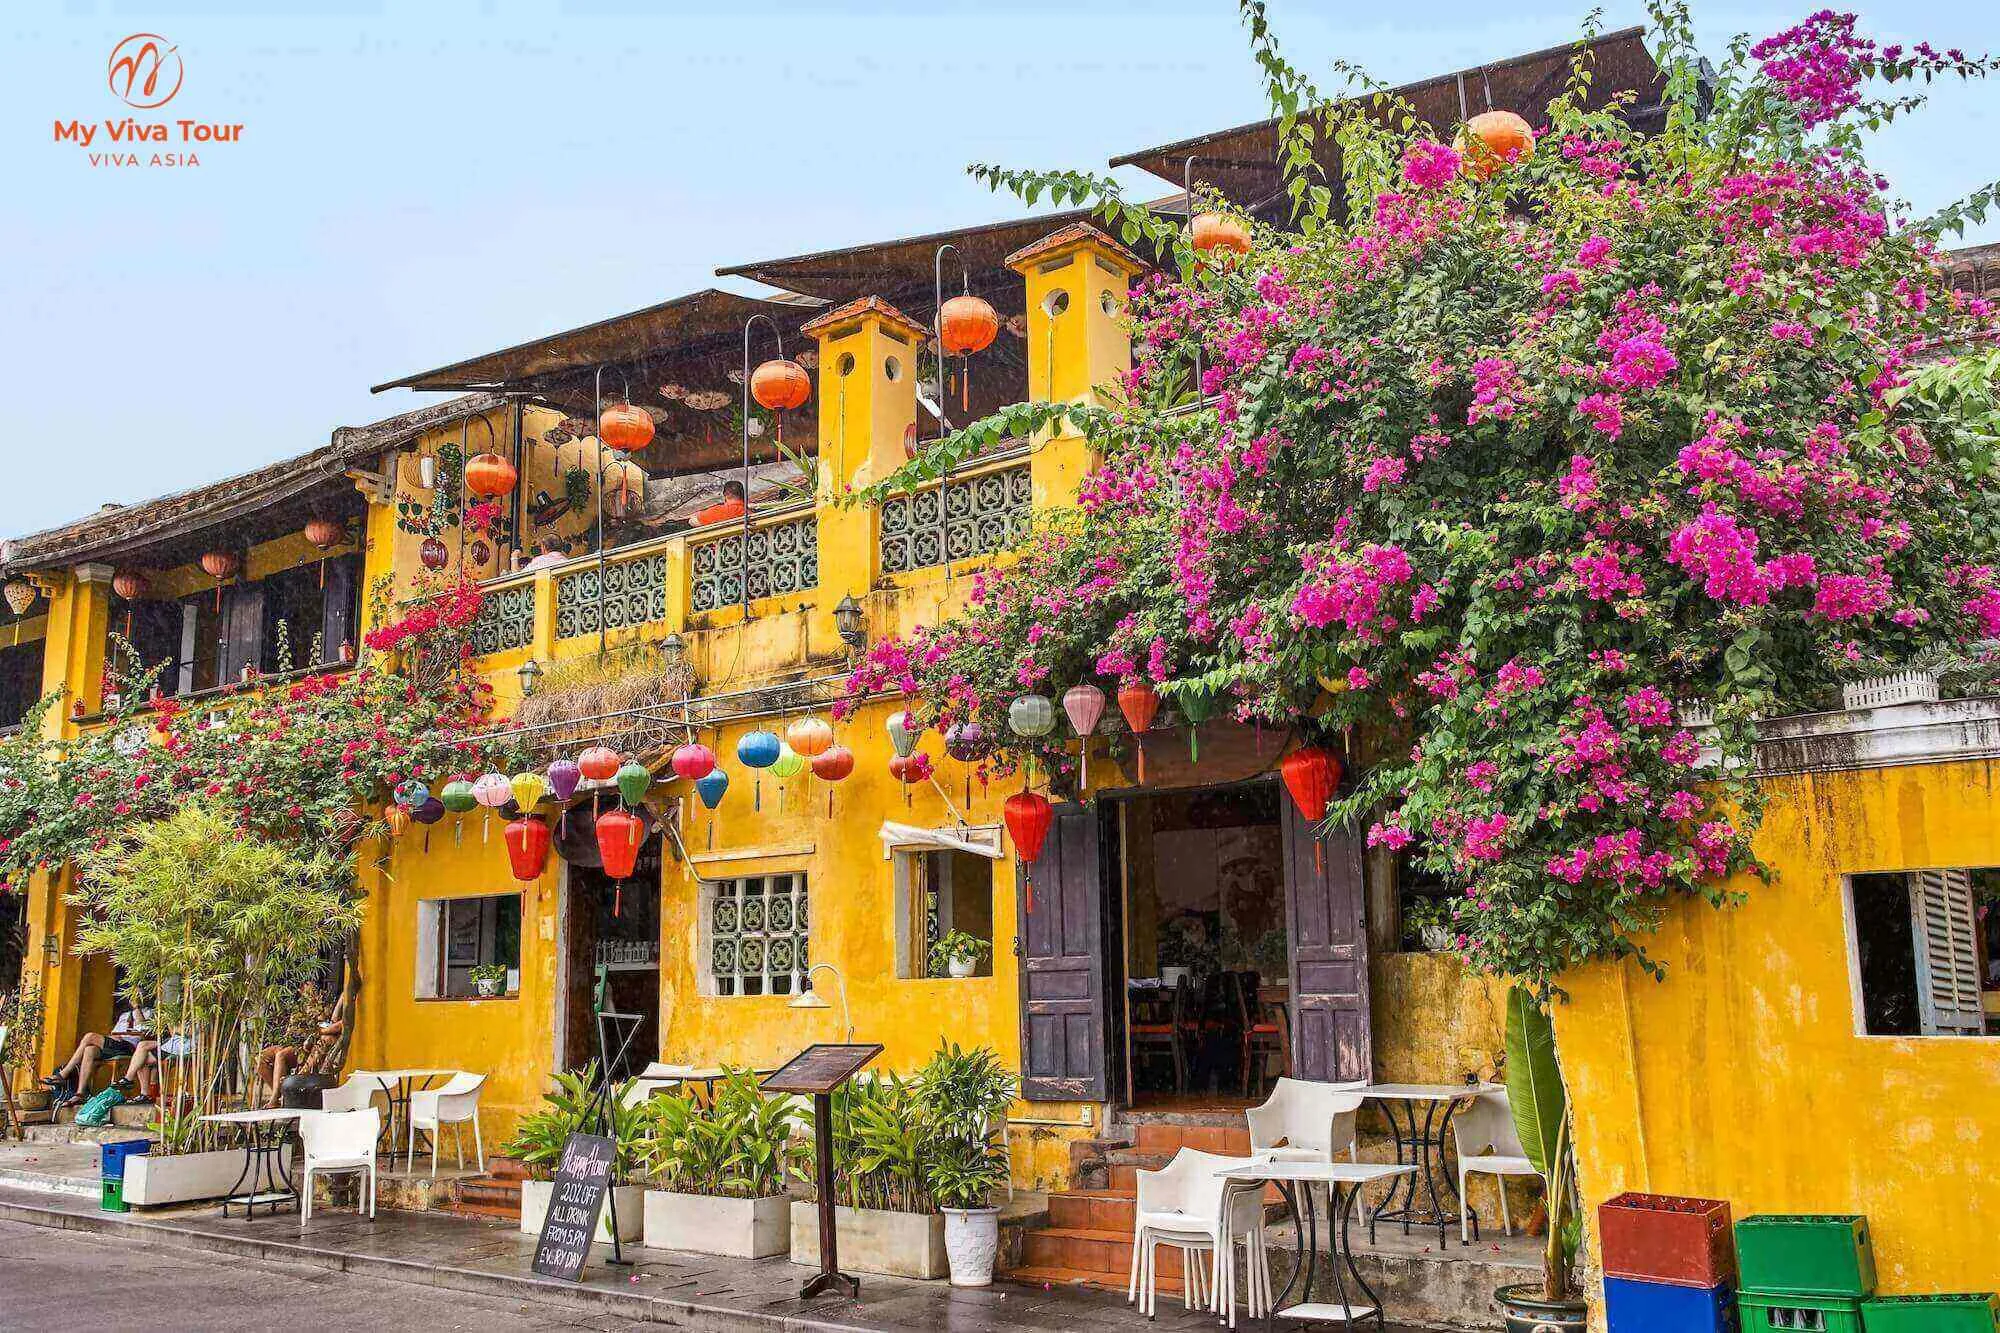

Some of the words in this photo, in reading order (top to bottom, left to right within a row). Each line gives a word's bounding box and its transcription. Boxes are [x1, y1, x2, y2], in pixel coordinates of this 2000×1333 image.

[561, 1142, 588, 1180] Happy
[586, 1143, 609, 1176] Hour
[560, 1183, 582, 1204] 20%
[580, 1185, 599, 1206] OFF
[551, 1205, 565, 1222] ALL
[566, 1207, 590, 1226] DRINK
[546, 1226, 568, 1243] FROM
[565, 1252, 583, 1269] DAY
